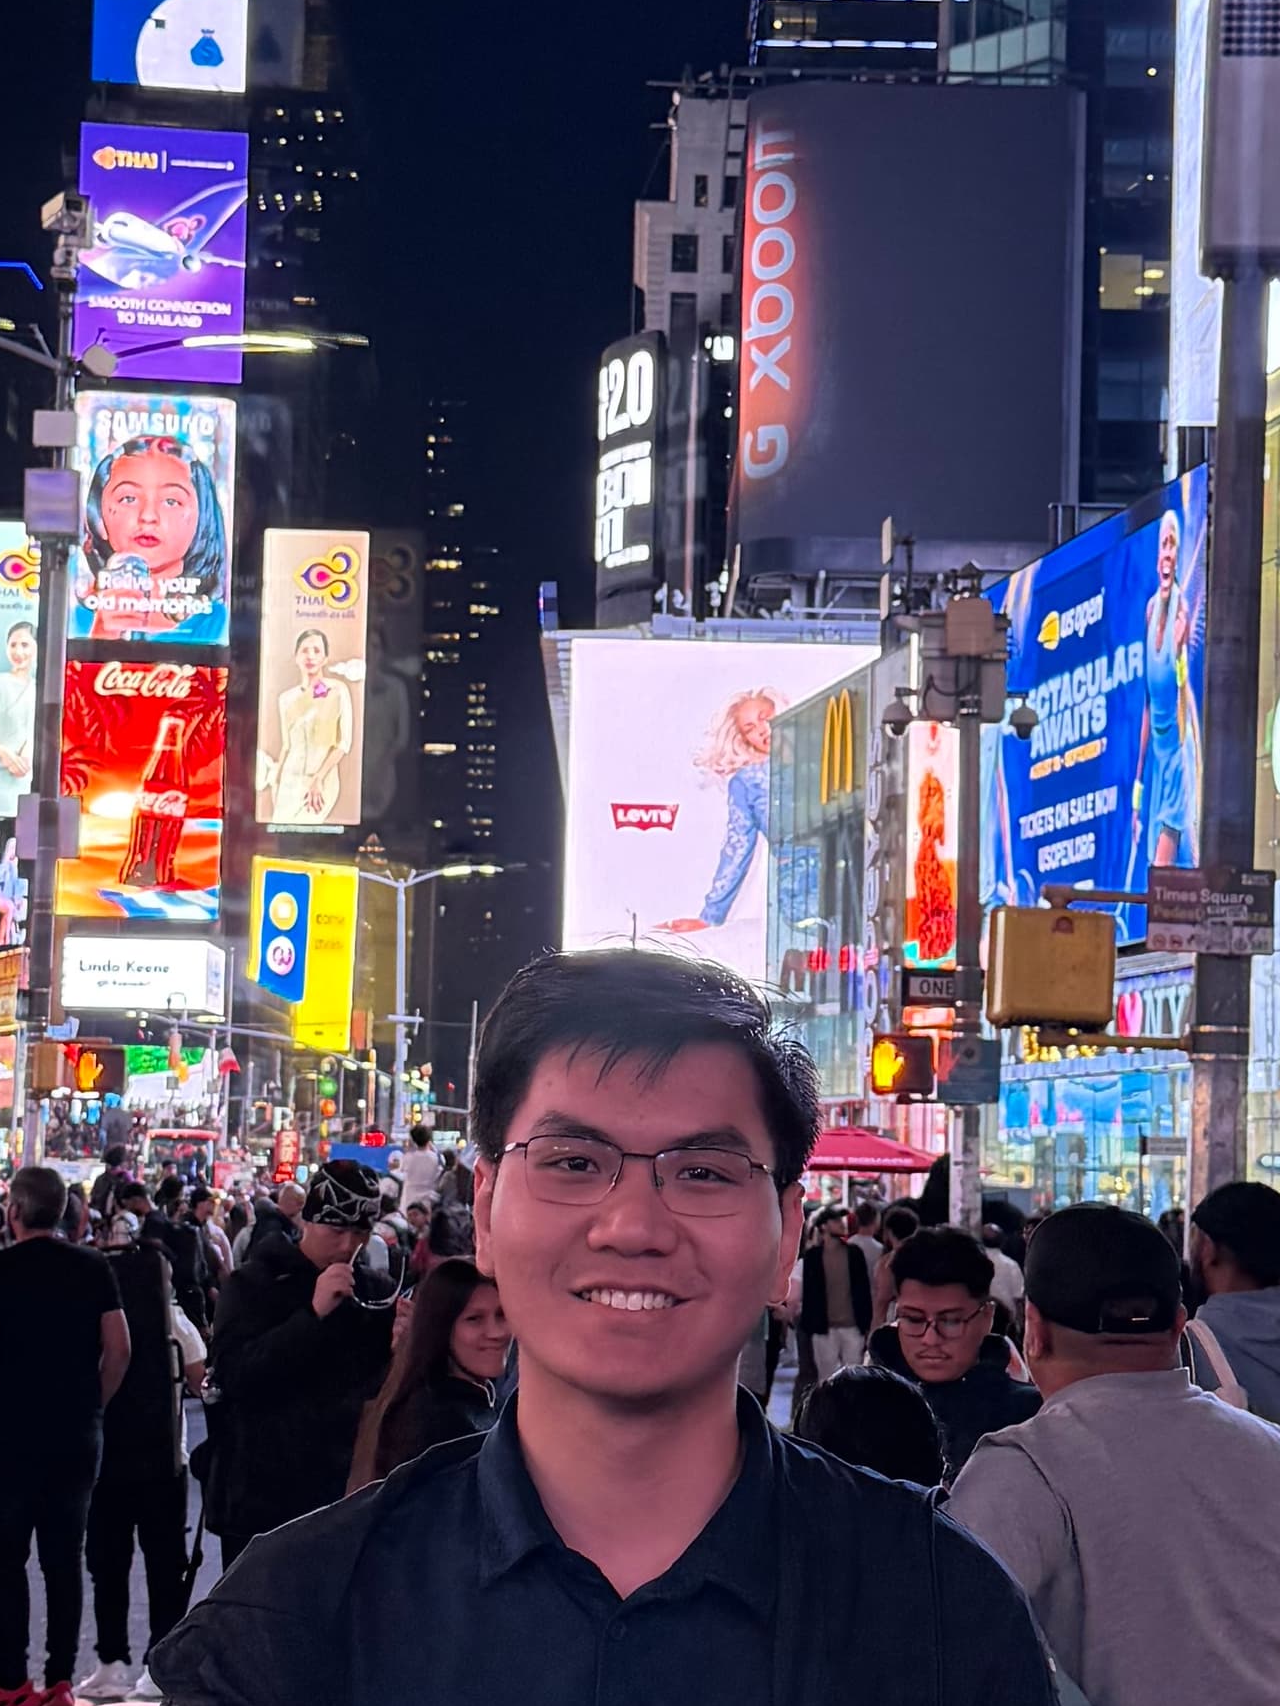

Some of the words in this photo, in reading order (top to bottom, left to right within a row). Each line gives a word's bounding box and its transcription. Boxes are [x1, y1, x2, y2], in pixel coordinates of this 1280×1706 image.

[117, 150, 159, 170] THAI
[89, 295, 146, 311] SMOOTH
[148, 299, 232, 316] CONNECTION
[117, 311, 136, 325] TO
[136, 313, 203, 329] THAILAND
[158, 575, 201, 594] your
[85, 596, 116, 611] old
[295, 596, 325, 606] THAI
[1030, 695, 1108, 759] AWAITS
[1153, 885, 1198, 902] Times
[1200, 888, 1255, 905] Square
[920, 979, 955, 994] ONE
[1143, 983, 1191, 1039] NY
